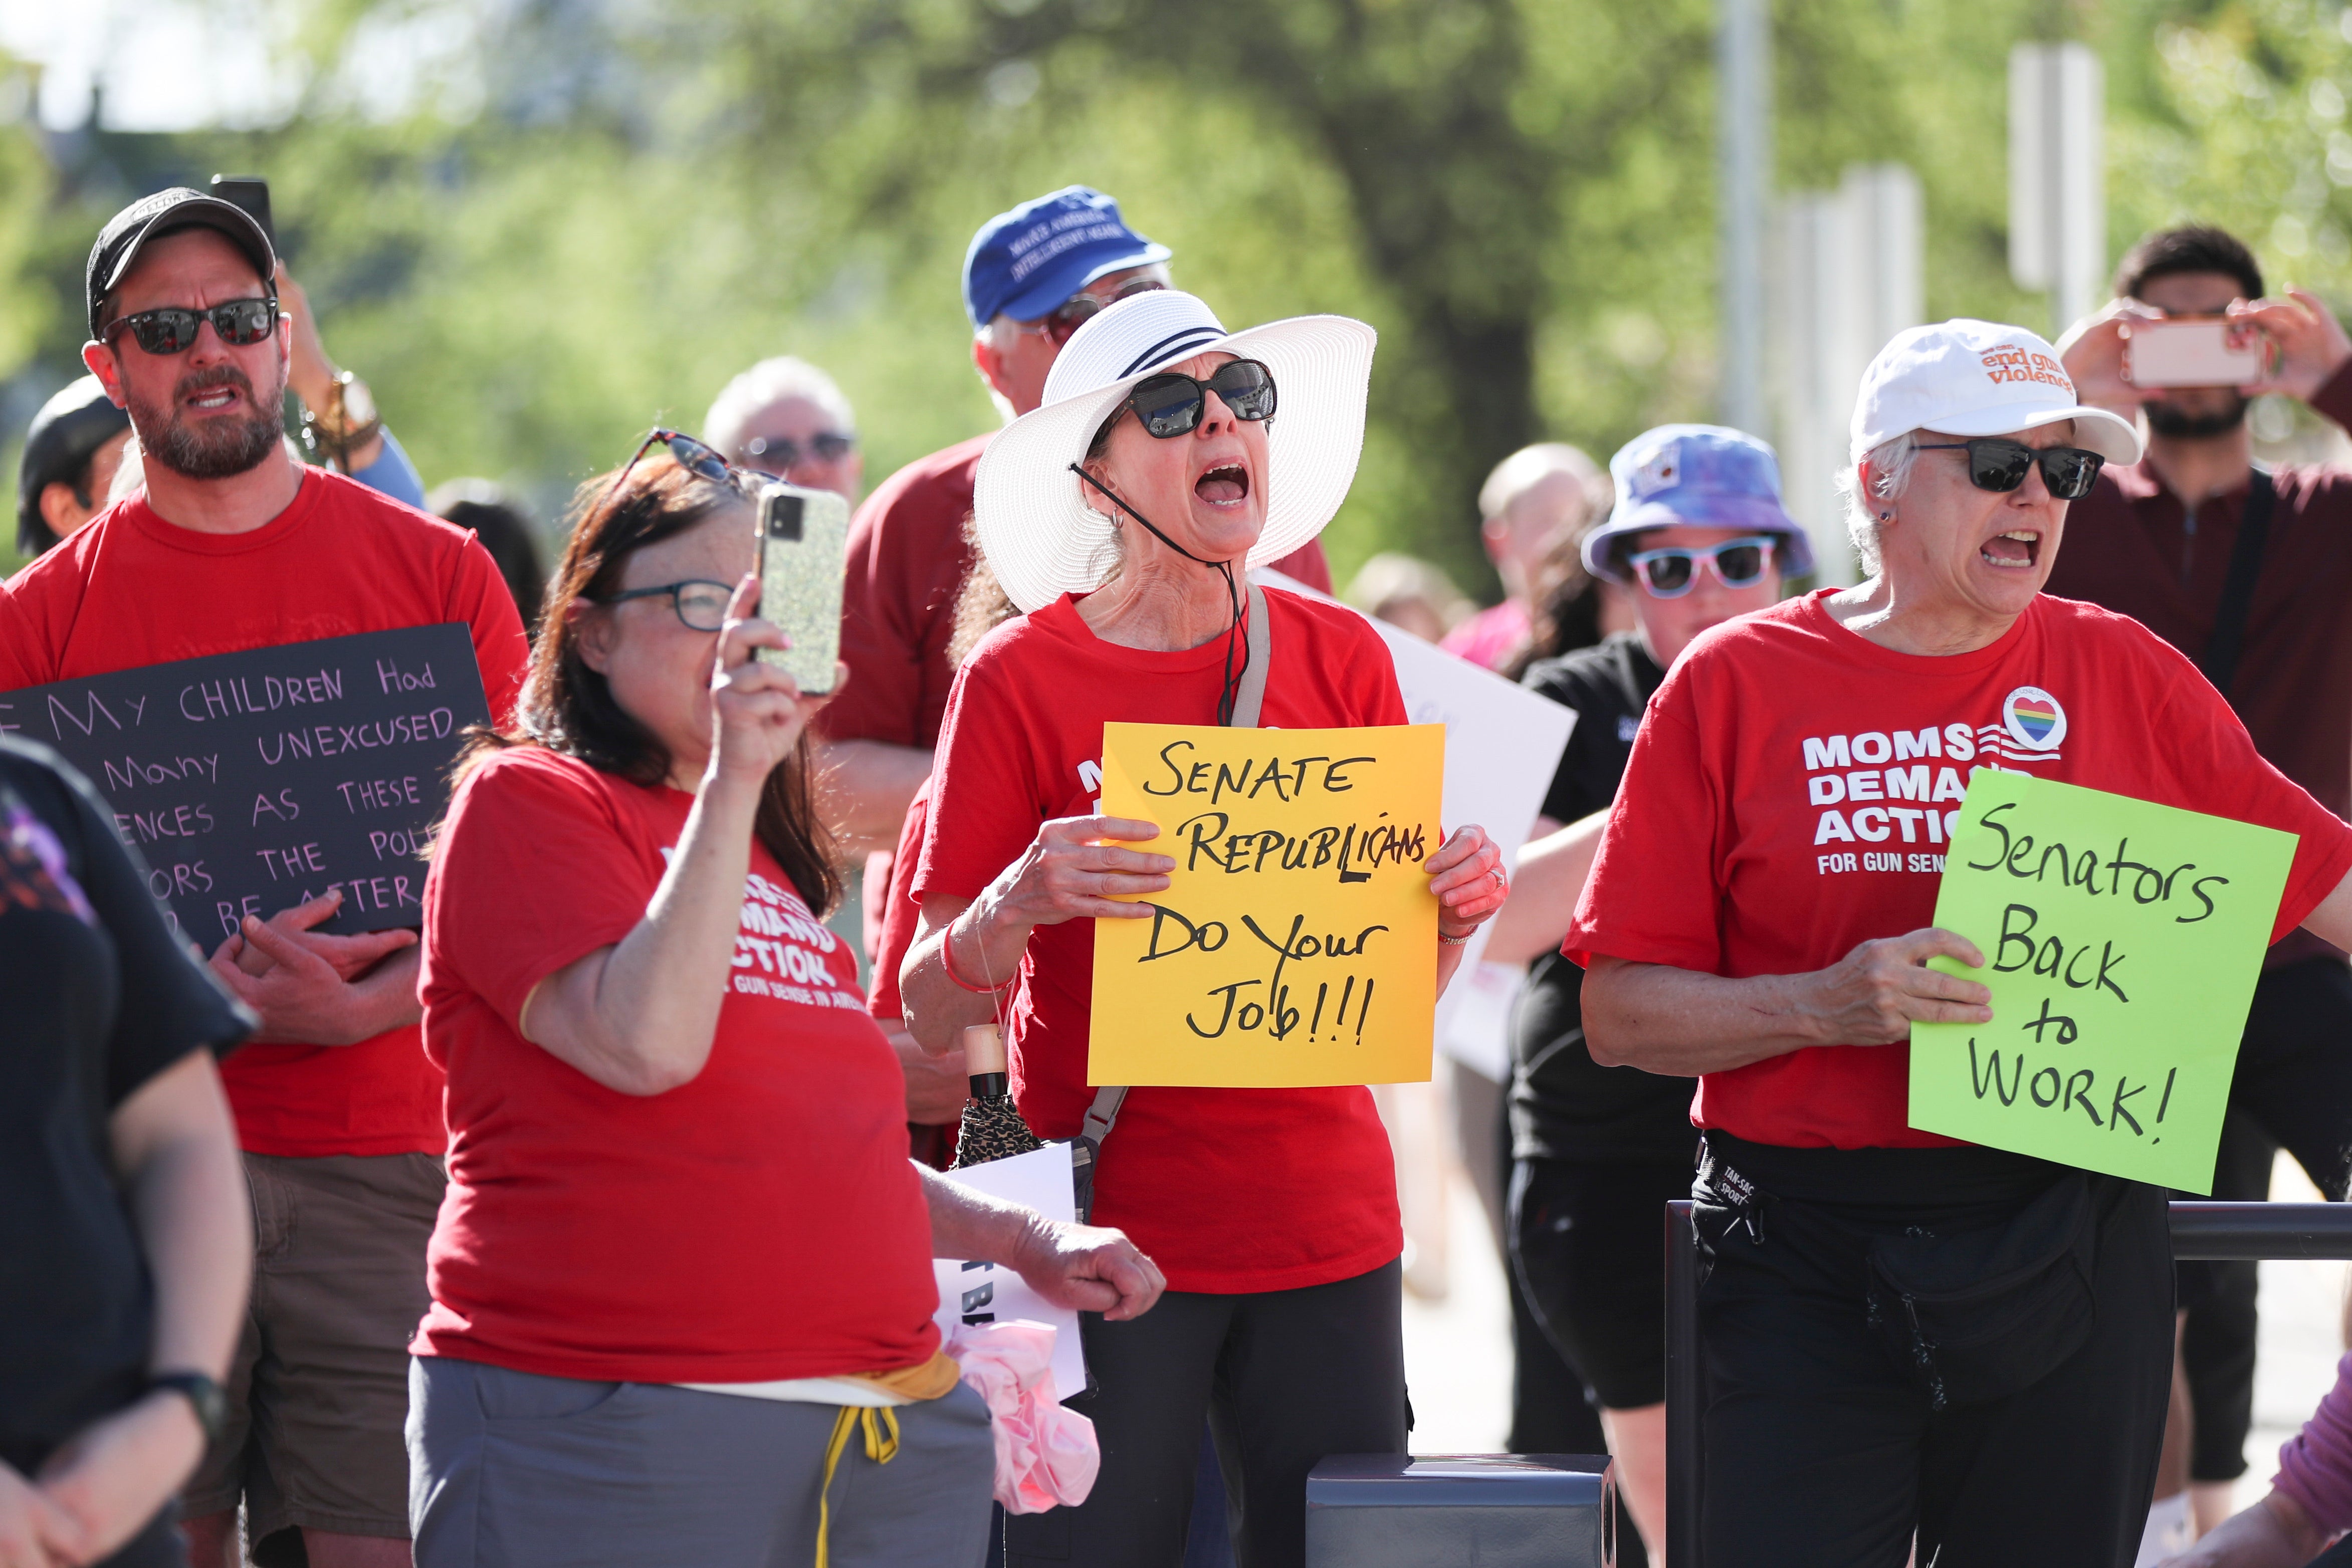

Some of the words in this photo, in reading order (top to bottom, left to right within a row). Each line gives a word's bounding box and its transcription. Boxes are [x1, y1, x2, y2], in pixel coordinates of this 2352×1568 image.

[1982, 348, 2030, 366] end
[2031, 353, 2065, 375] gun
[180, 668, 342, 722] CHILDREN
[259, 707, 453, 765] UNEXCUSED
[1803, 723, 1975, 770] MOMS
[1143, 741, 1376, 805] SENATE
[1808, 762, 2034, 806] DEMA
[113, 803, 214, 845] ENCES
[253, 788, 299, 827] AS
[337, 776, 420, 815] THESE
[1814, 807, 1961, 845] ACTI
[256, 842, 326, 880] THE
[1176, 812, 1425, 883] REPUBLICANS
[1818, 853, 1857, 875] FOR
[1863, 853, 1902, 872] GUN
[1908, 854, 1948, 873] SEN
[1968, 802, 2229, 923] Senators
[740, 902, 836, 953] MAND
[1992, 903, 2129, 1003] Back
[731, 935, 836, 987] CTION
[1138, 901, 1228, 962] Do
[1241, 914, 1389, 1015] Your
[734, 975, 770, 996] GUN
[769, 982, 814, 1005] SENSE
[1186, 976, 1374, 1046] Job!!!
[2022, 998, 2078, 1045] to
[1969, 1037, 2177, 1145] WORK!
[1721, 1183, 1748, 1206] SPORT
[1724, 1166, 1754, 1196] TAN-SAC
